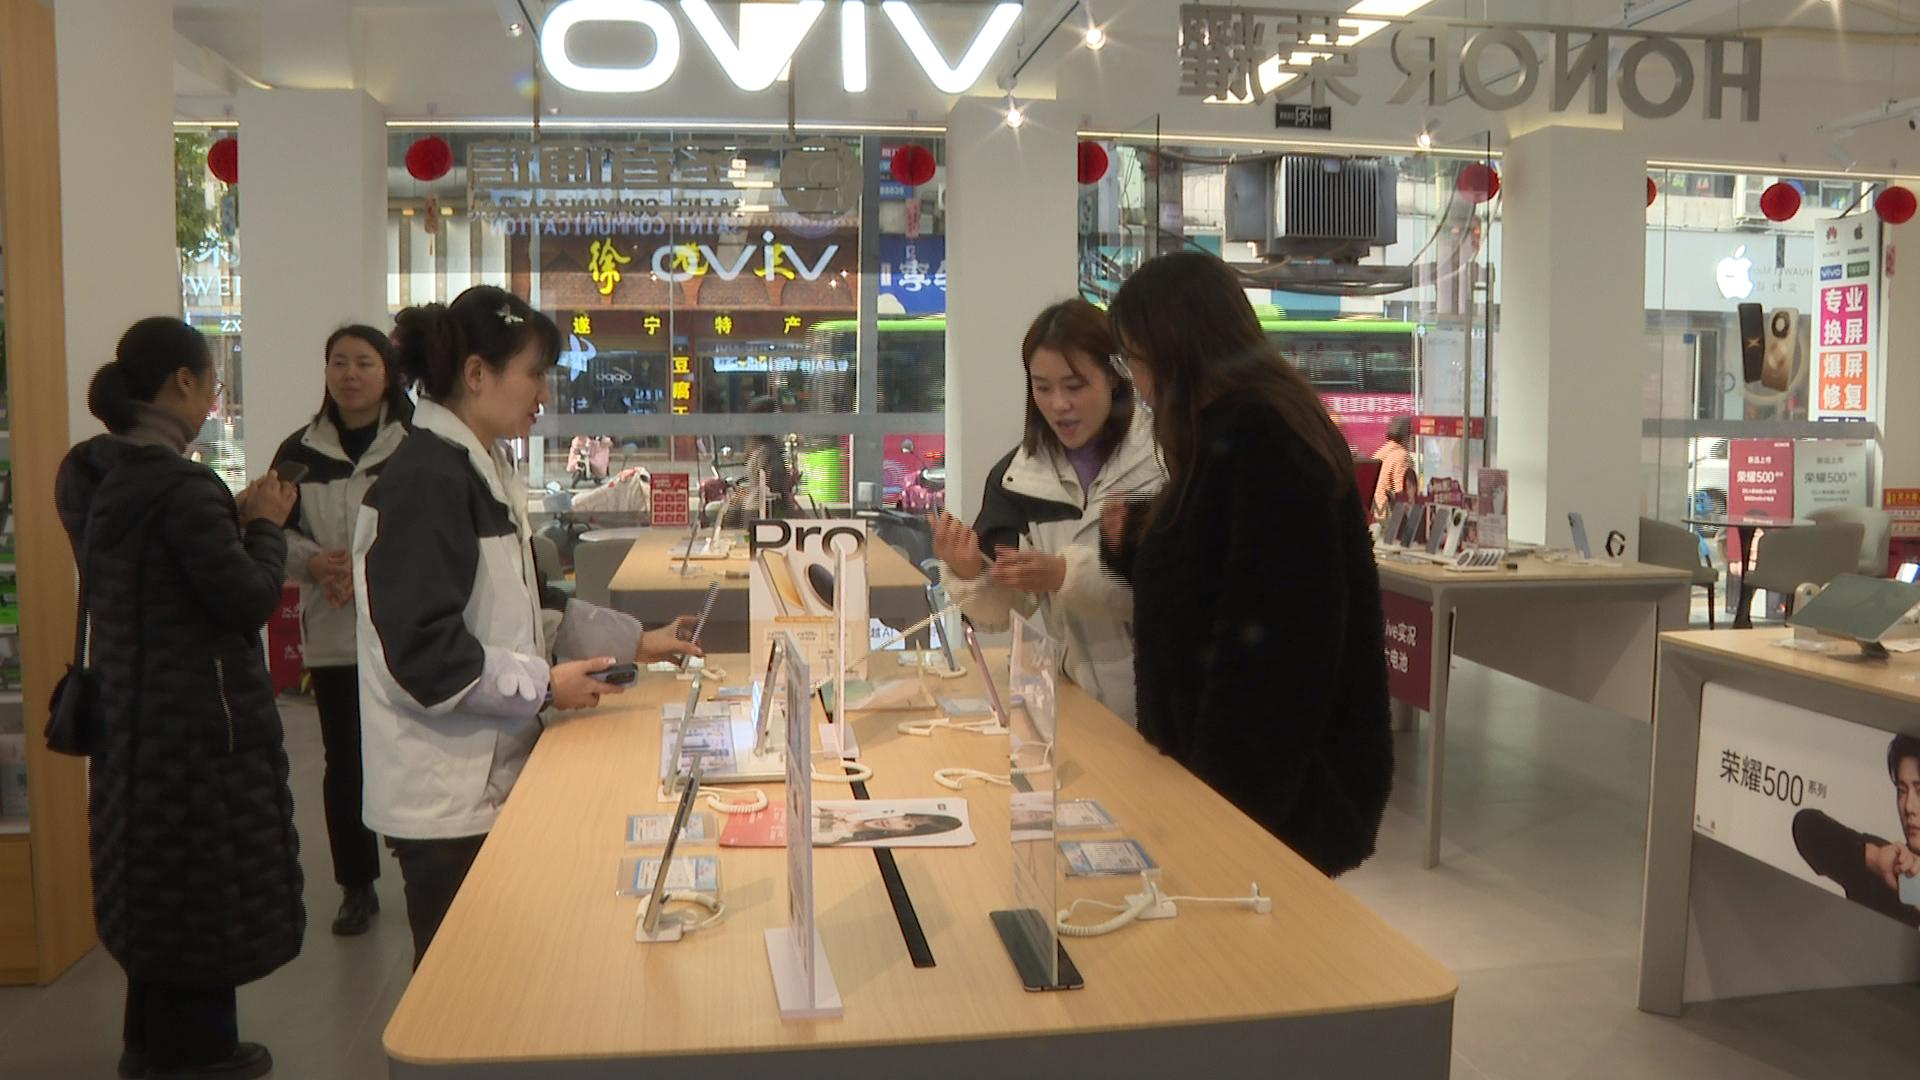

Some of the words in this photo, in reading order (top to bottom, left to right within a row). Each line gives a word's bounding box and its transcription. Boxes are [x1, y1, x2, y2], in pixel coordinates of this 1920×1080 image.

[1824, 287, 1863, 314] 专业
[573, 315, 802, 336] 遂宁特产
[1824, 318, 1864, 345] 换屏
[1823, 353, 1863, 379] 爆屏
[1823, 383, 1863, 410] 修复
[750, 520, 867, 560] Pro
[1385, 619, 1417, 647] ive实况
[1719, 749, 1804, 806] 荣耀500
